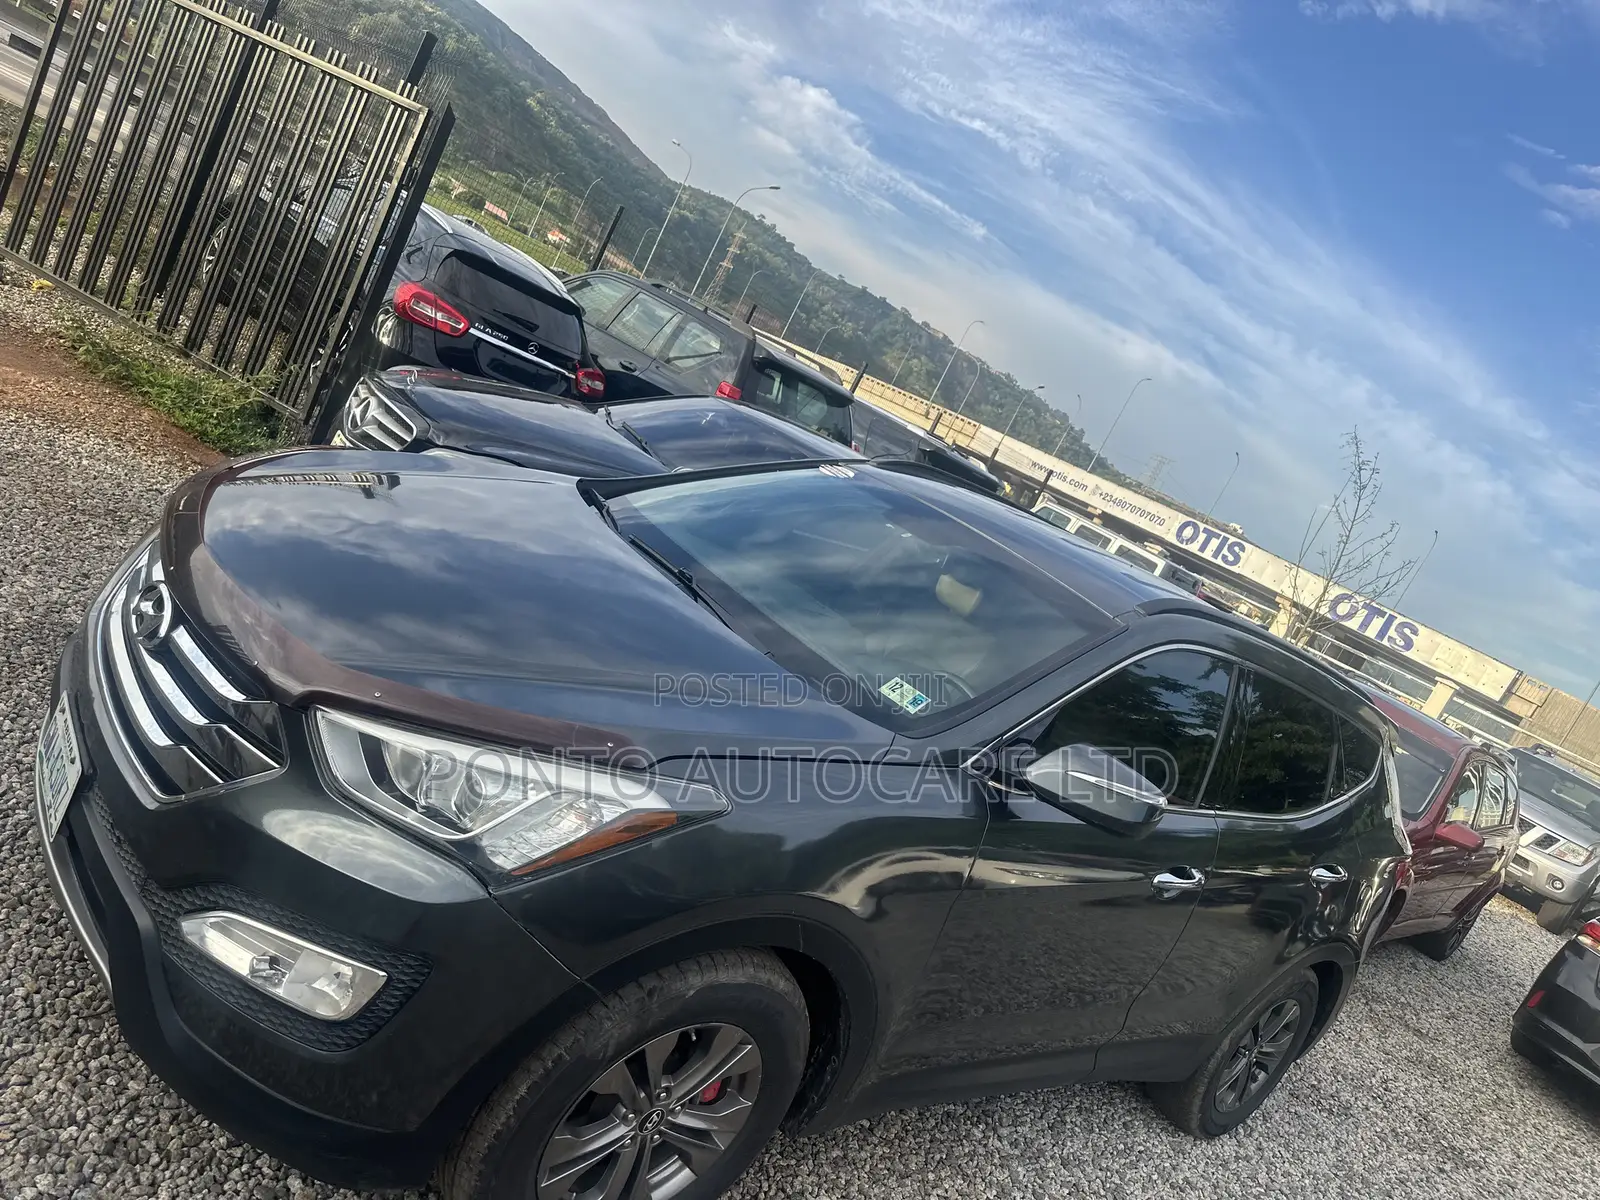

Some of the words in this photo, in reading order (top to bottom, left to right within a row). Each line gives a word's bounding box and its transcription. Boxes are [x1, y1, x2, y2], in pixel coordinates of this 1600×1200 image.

[1030, 460, 1088, 492] wwwotis.com
[1175, 519, 1246, 567] OTIS
[1328, 592, 1420, 653] OTIS
